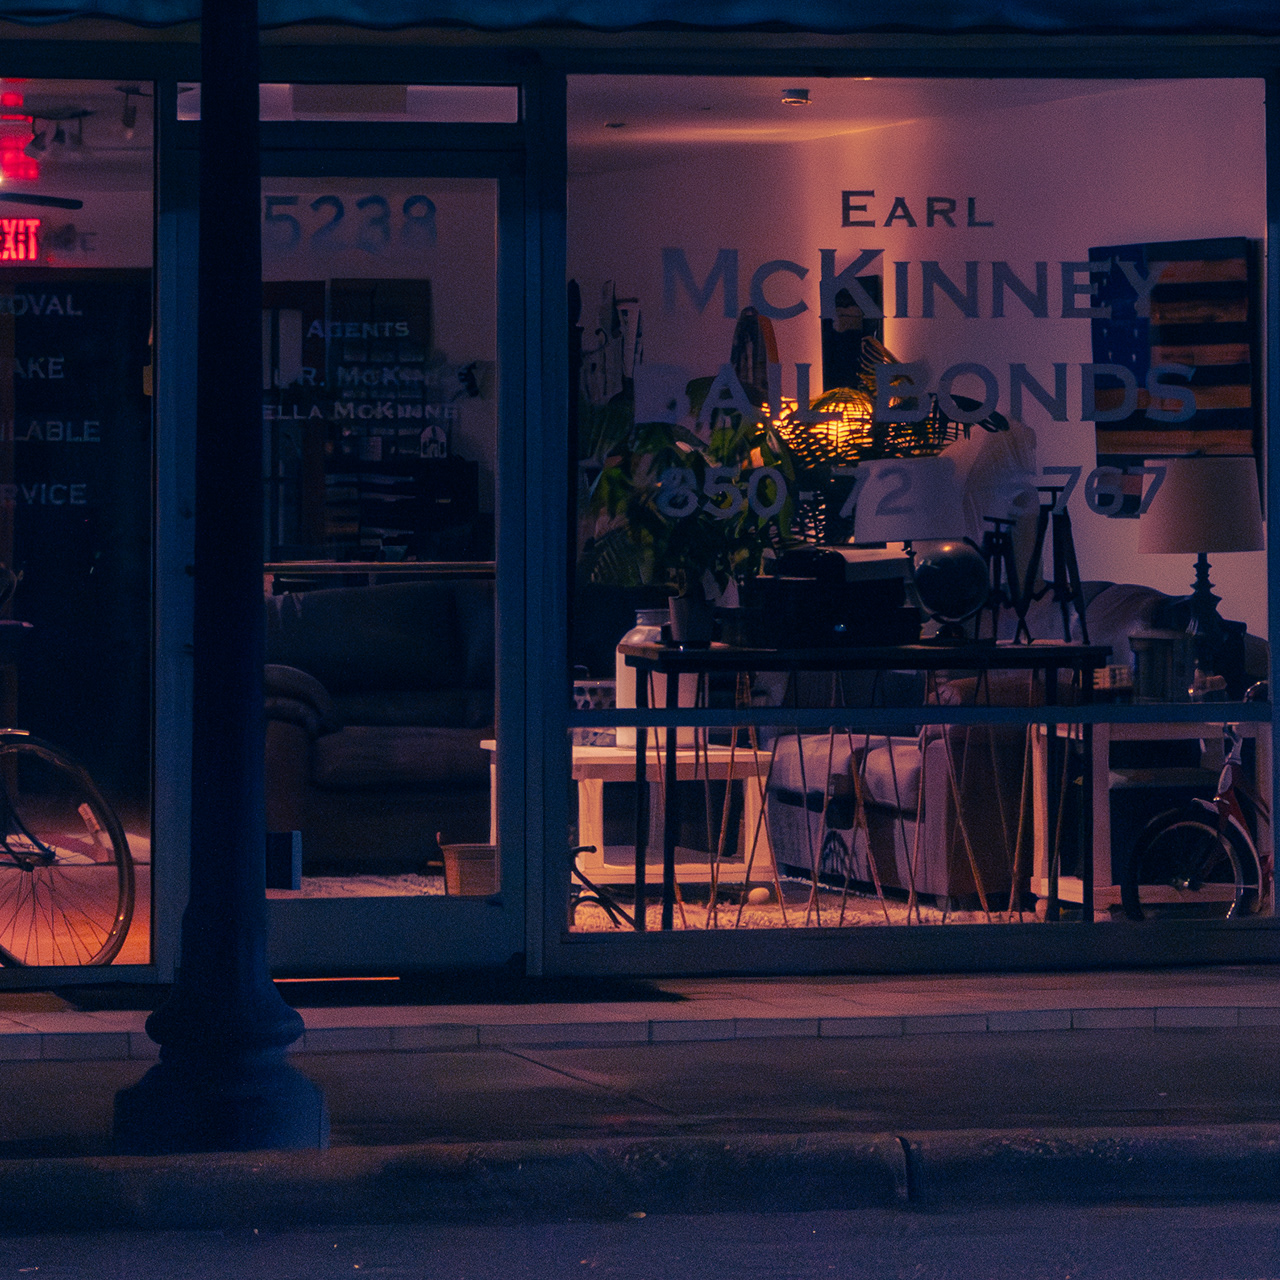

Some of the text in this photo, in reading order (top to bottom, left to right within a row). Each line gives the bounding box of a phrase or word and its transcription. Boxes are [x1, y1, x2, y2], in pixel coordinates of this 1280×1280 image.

[265, 195, 437, 255] 5238
[841, 189, 995, 228] EARL
[307, 319, 410, 339] AGENTS
[875, 362, 1197, 425] BONDS
